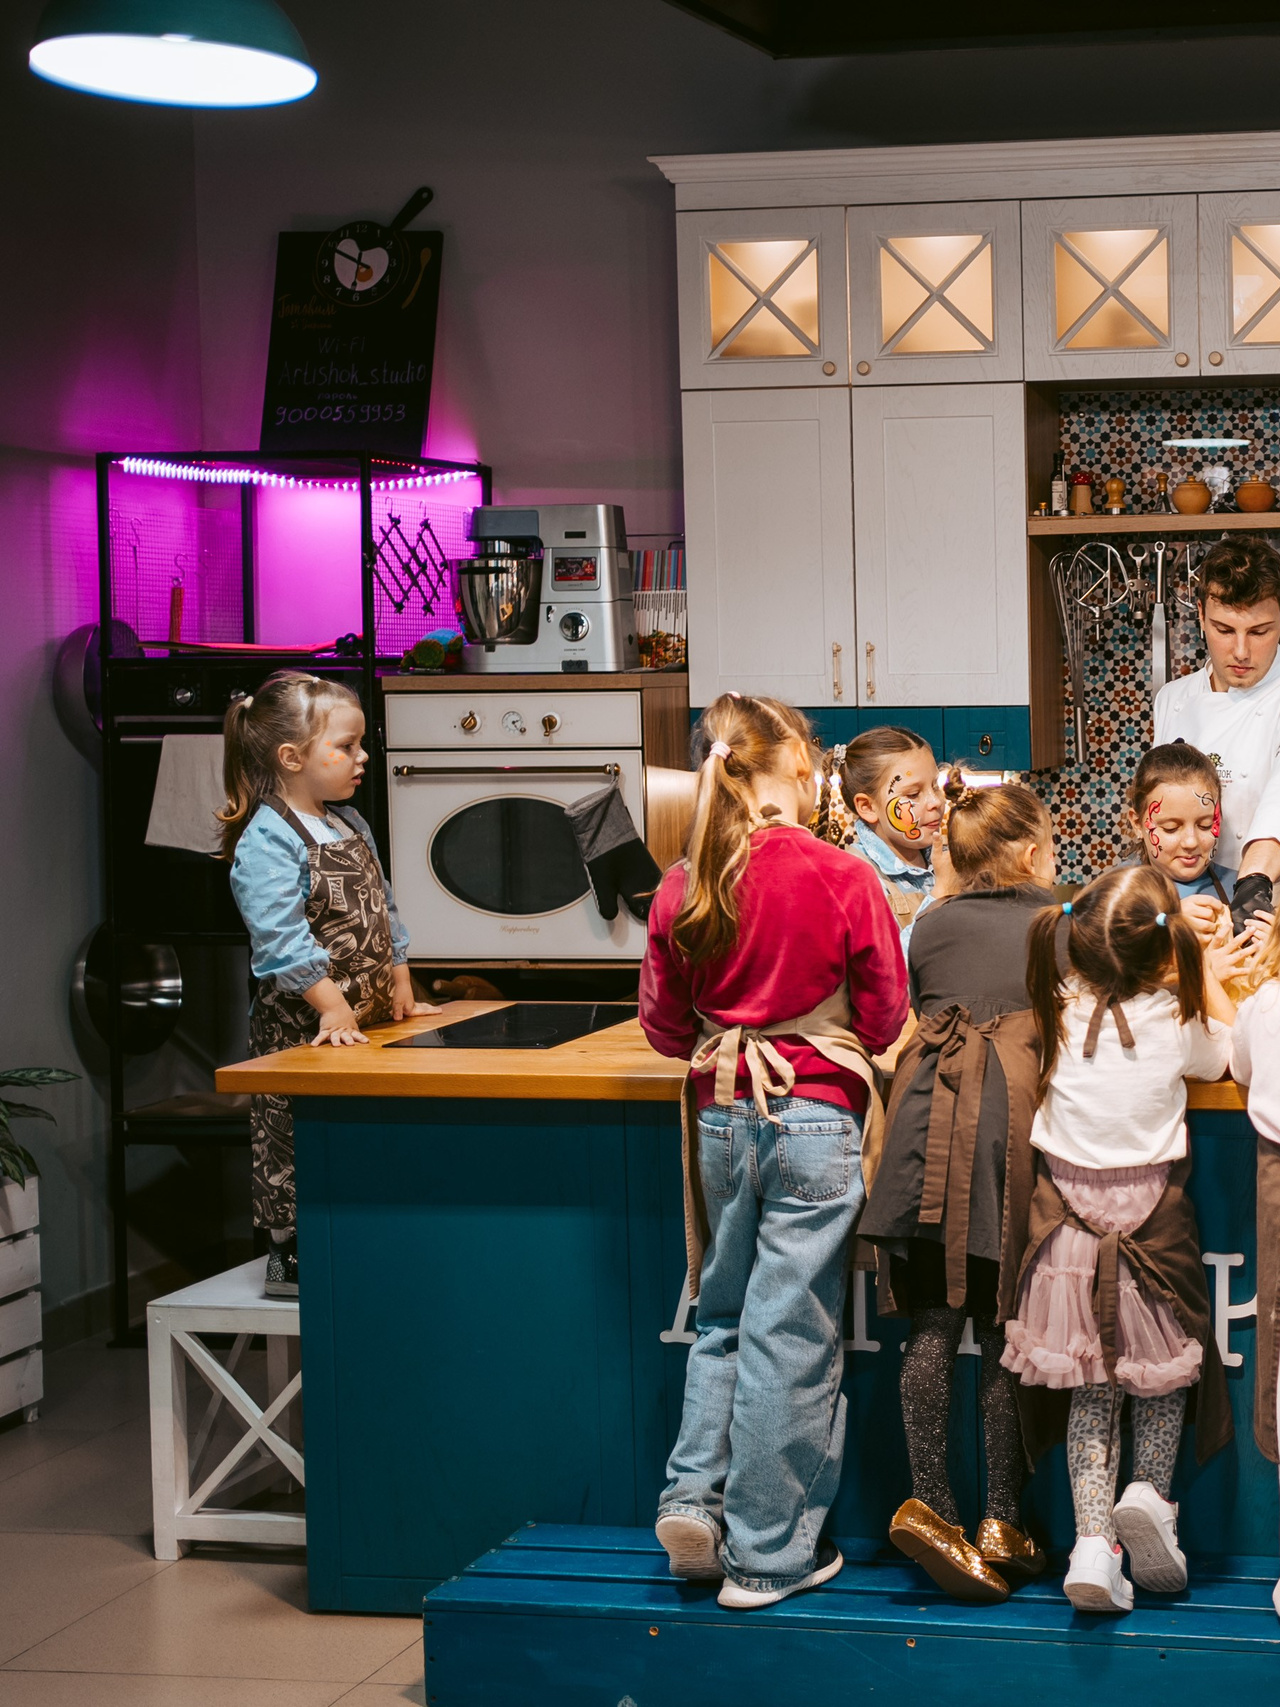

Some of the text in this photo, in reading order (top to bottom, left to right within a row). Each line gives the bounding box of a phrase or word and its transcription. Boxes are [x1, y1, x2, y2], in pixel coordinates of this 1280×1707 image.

[356, 224, 368, 233] 12
[386, 240, 393, 250] 2
[321, 258, 329, 268] 9
[389, 258, 397, 268] 3
[323, 275, 331, 284] 8
[383, 274, 390, 284] 4
[335, 287, 342, 296] 7
[352, 292, 360, 302] 6
[275, 404, 406, 426] 9000559953
